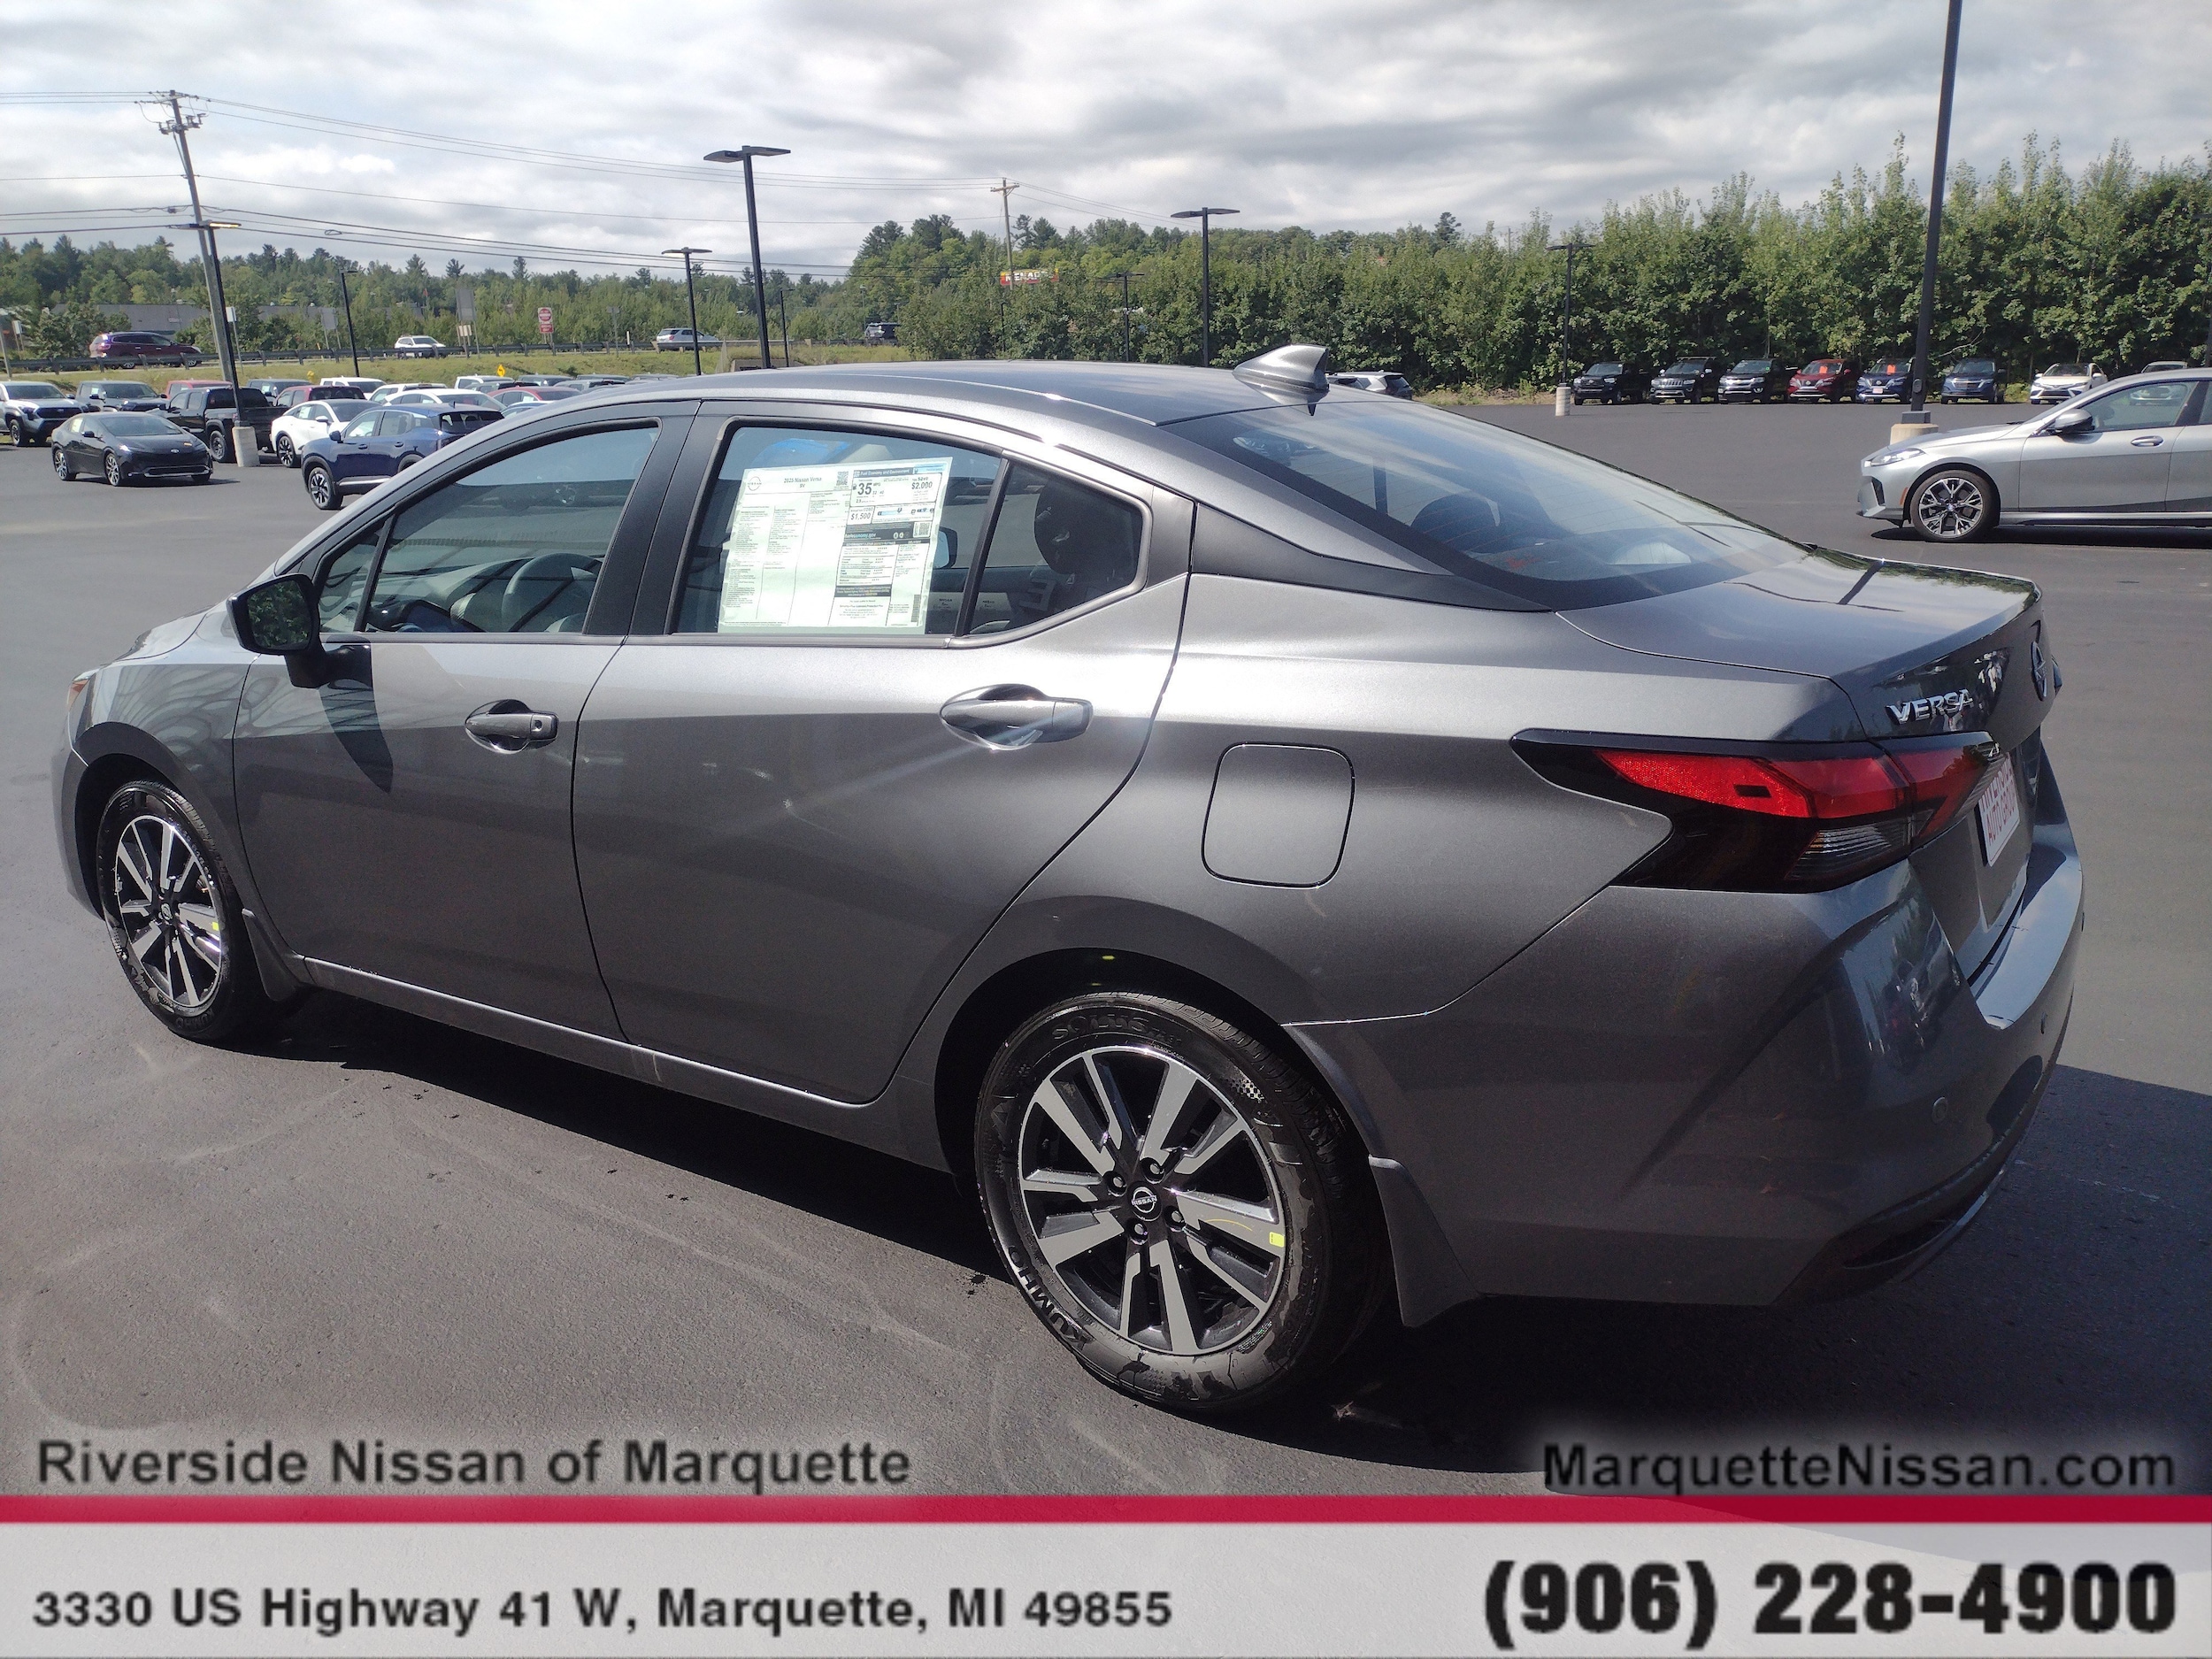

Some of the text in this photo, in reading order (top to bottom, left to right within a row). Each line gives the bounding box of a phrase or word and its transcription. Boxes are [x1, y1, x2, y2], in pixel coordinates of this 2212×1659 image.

[857, 482, 872, 495] 35
[1885, 688, 1974, 725] VERSA
[1131, 1194, 1158, 1206] NISSAN
[1009, 1245, 1088, 1351] KUMHO
